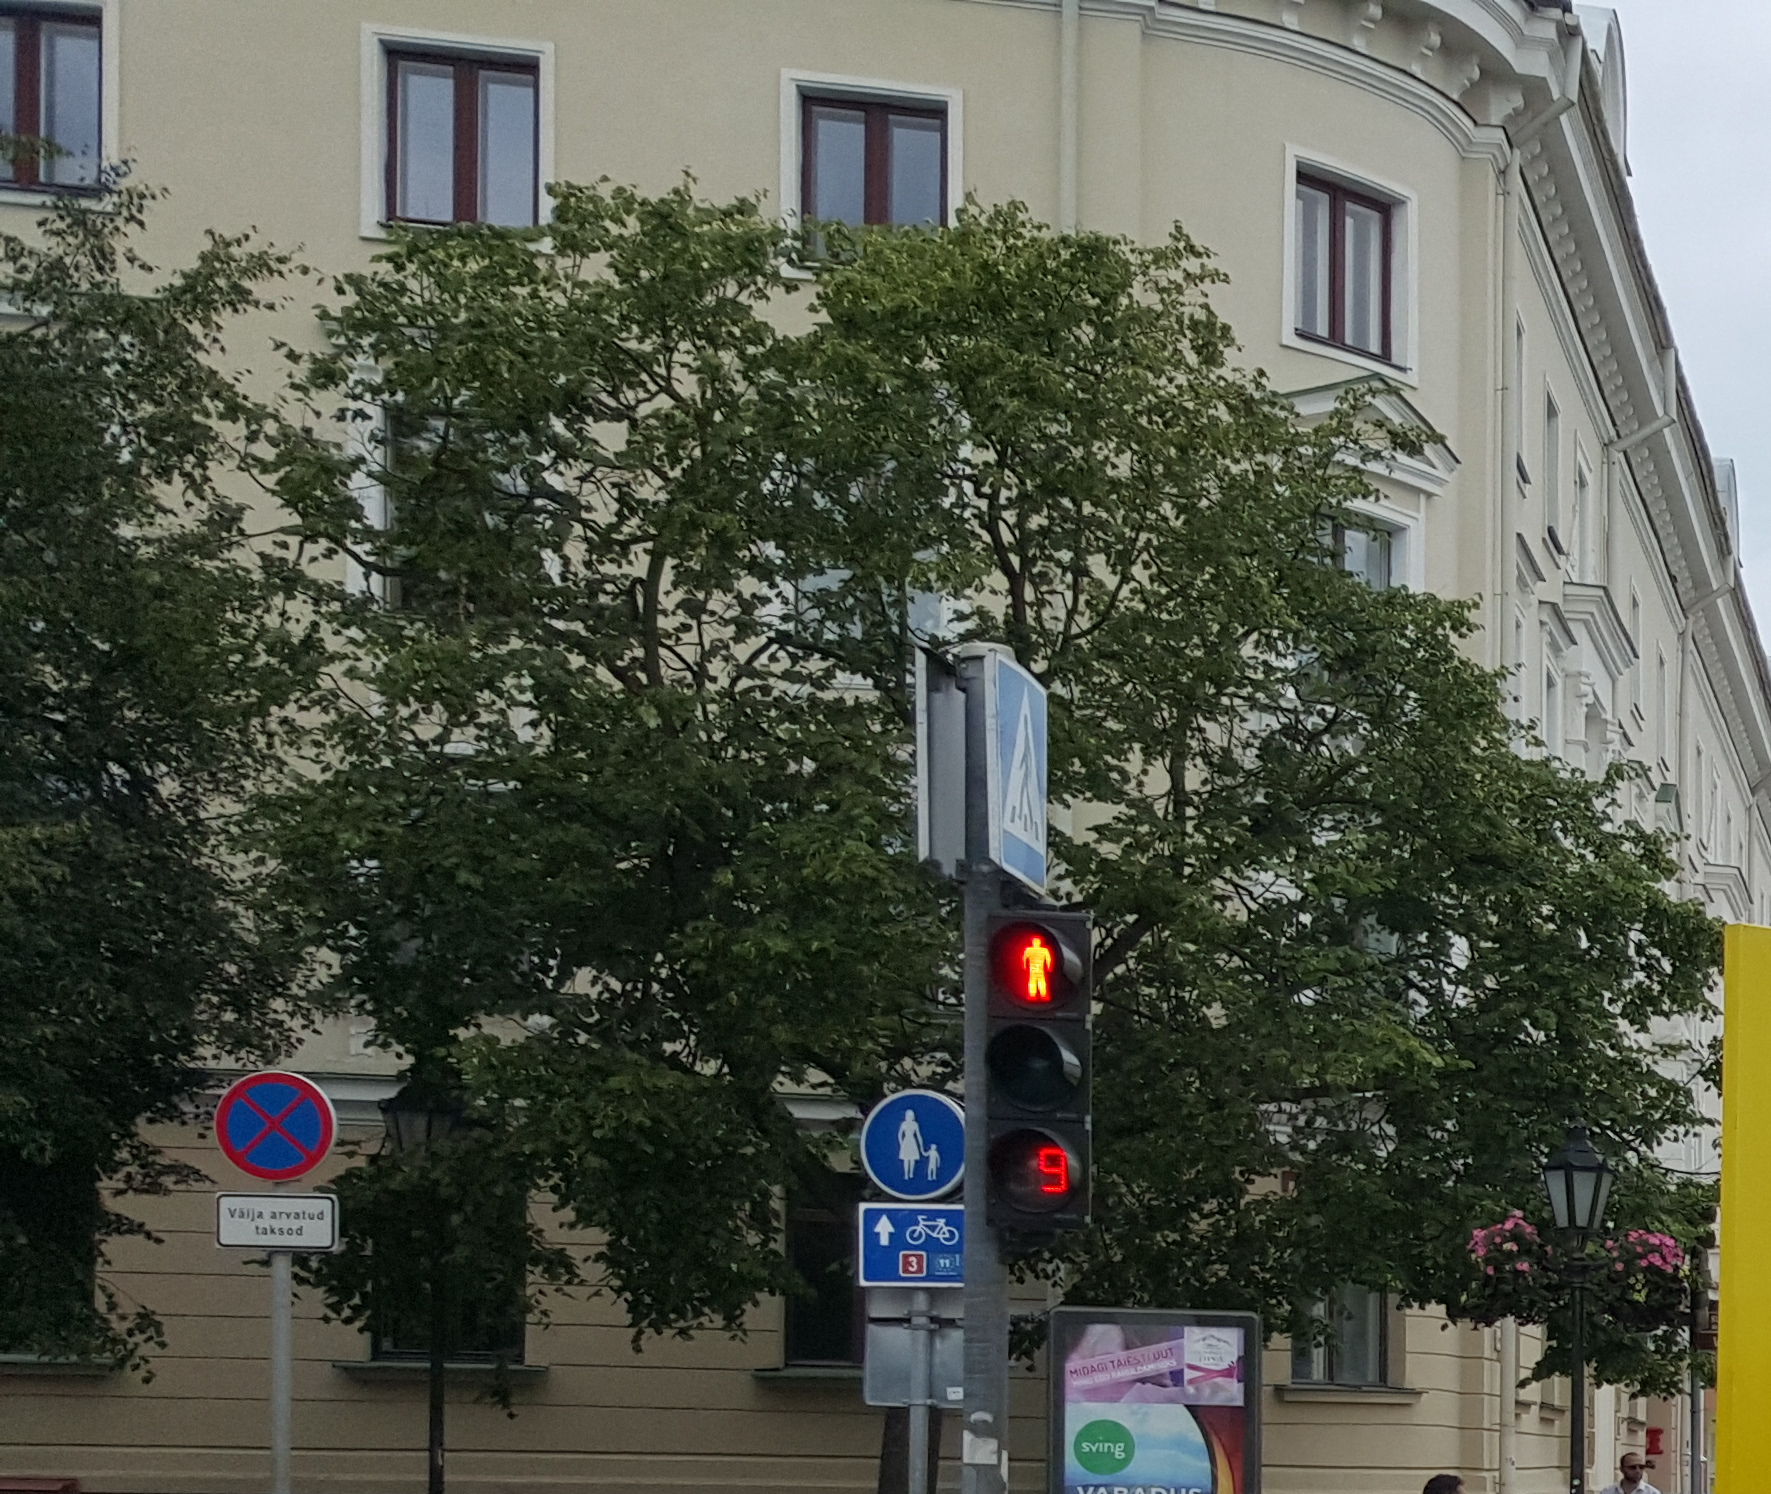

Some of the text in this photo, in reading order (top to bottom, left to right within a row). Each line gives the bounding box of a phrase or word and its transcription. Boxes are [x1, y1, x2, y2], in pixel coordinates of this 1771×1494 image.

[1039, 1148, 1068, 1193] 9
[228, 1207, 324, 1221] Välja arvatud
[255, 1225, 303, 1236] taksod
[908, 1256, 918, 1272] 3
[1069, 1362, 1107, 1378] MIDAGI
[1153, 1348, 1174, 1361] UUT
[1081, 1436, 1125, 1459] sving
